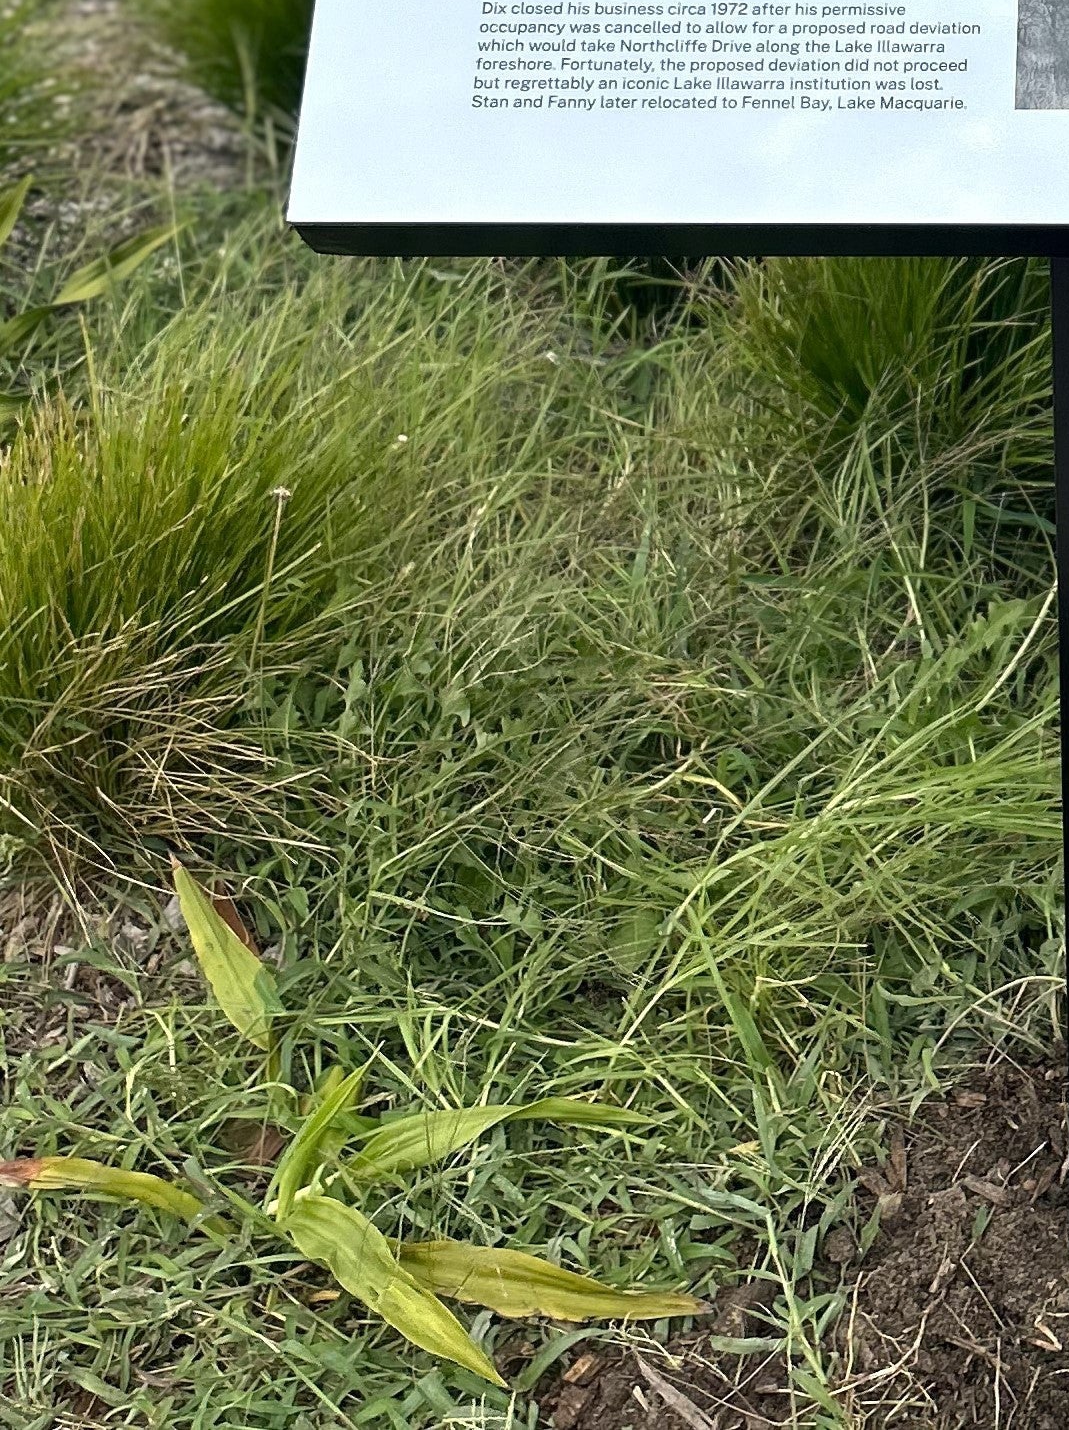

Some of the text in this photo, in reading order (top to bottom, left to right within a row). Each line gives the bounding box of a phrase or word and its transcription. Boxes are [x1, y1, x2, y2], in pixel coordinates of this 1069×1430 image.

[481, 2, 906, 19] Dix closed his business circa 1972 after his permissive
[477, 39, 946, 56] which would take Northcliffe Drive along the Lake Illawarra
[475, 57, 968, 75] foreshore. Fortunately, the proposed deviation did not proceed
[473, 76, 944, 93] but regrettably an iconic Lake Illawarra institution was lost.
[471, 95, 968, 113] Stan and Fanny later relocated to Fennel Bay, Lake Macquarie.
